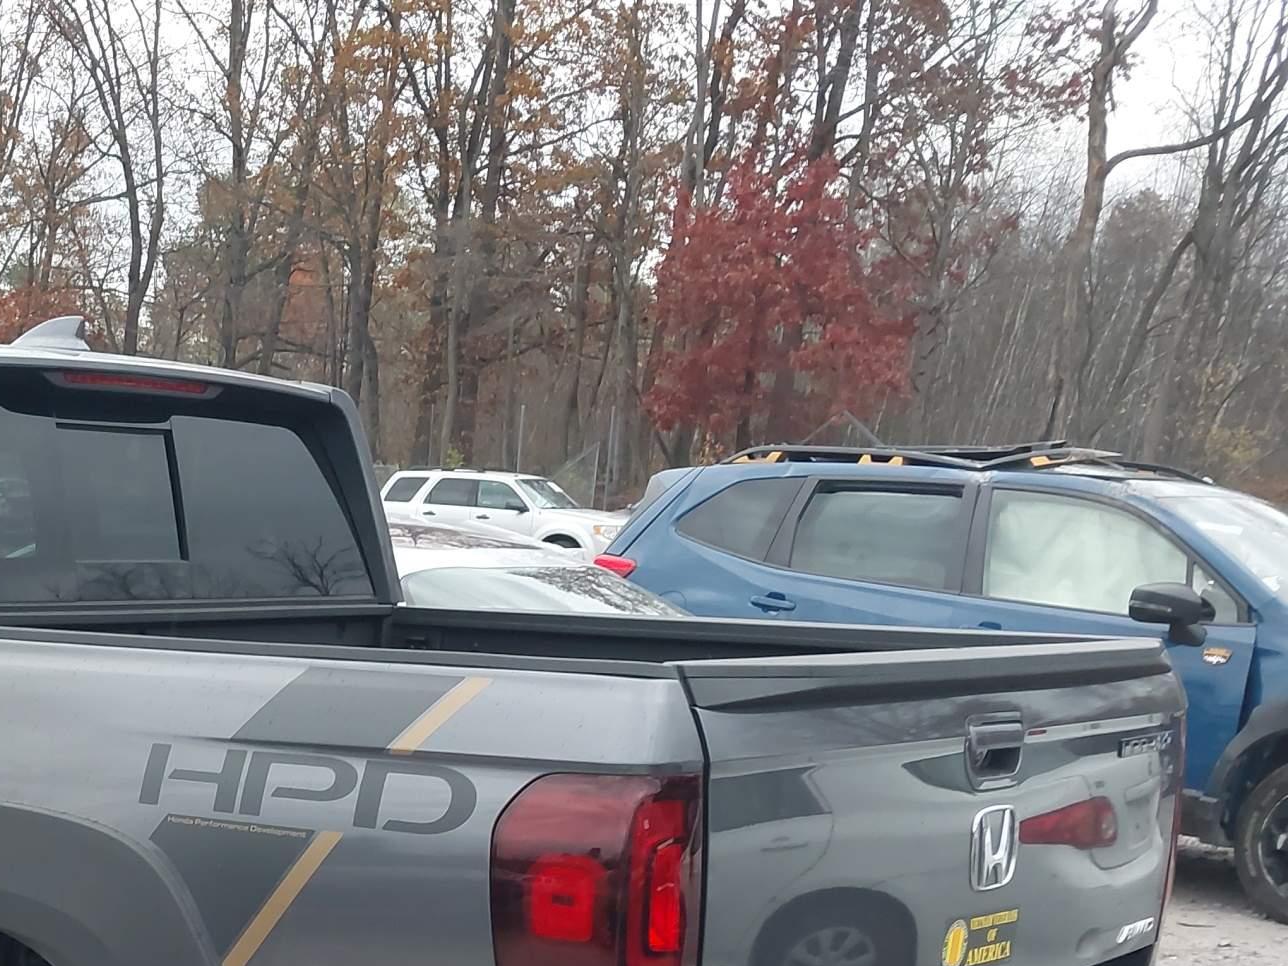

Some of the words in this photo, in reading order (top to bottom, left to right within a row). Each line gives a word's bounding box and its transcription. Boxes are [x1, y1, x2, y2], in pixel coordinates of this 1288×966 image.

[138, 743, 478, 835] HPD
[167, 815, 194, 826] Honda
[964, 941, 1010, 966] AMERICA
